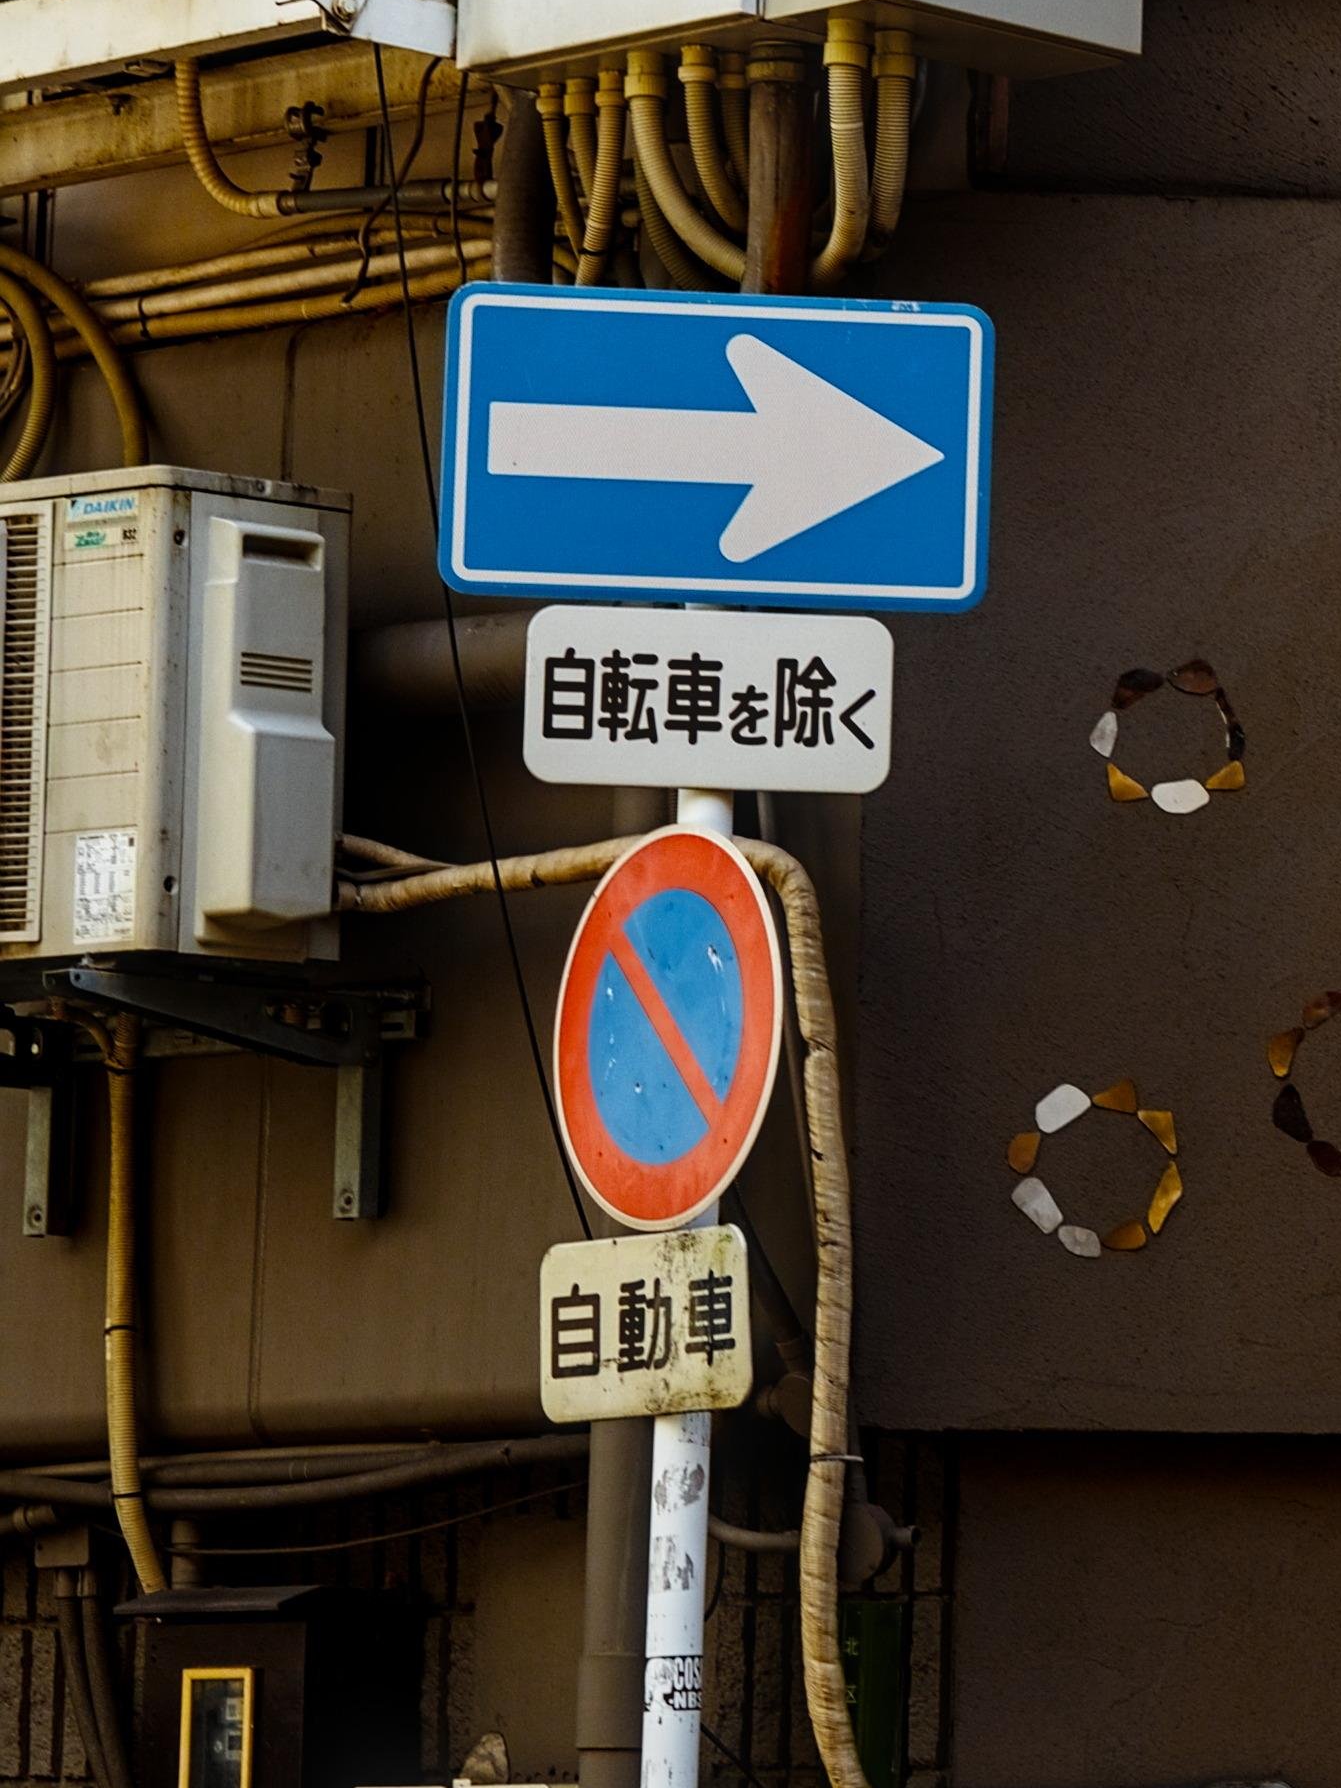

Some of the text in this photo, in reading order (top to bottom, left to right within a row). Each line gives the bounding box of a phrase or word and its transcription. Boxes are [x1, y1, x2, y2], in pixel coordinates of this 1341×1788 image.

[84, 497, 135, 515] DAIKIN
[541, 647, 876, 750] 自転車を除く
[550, 1269, 735, 1380] 自動車
